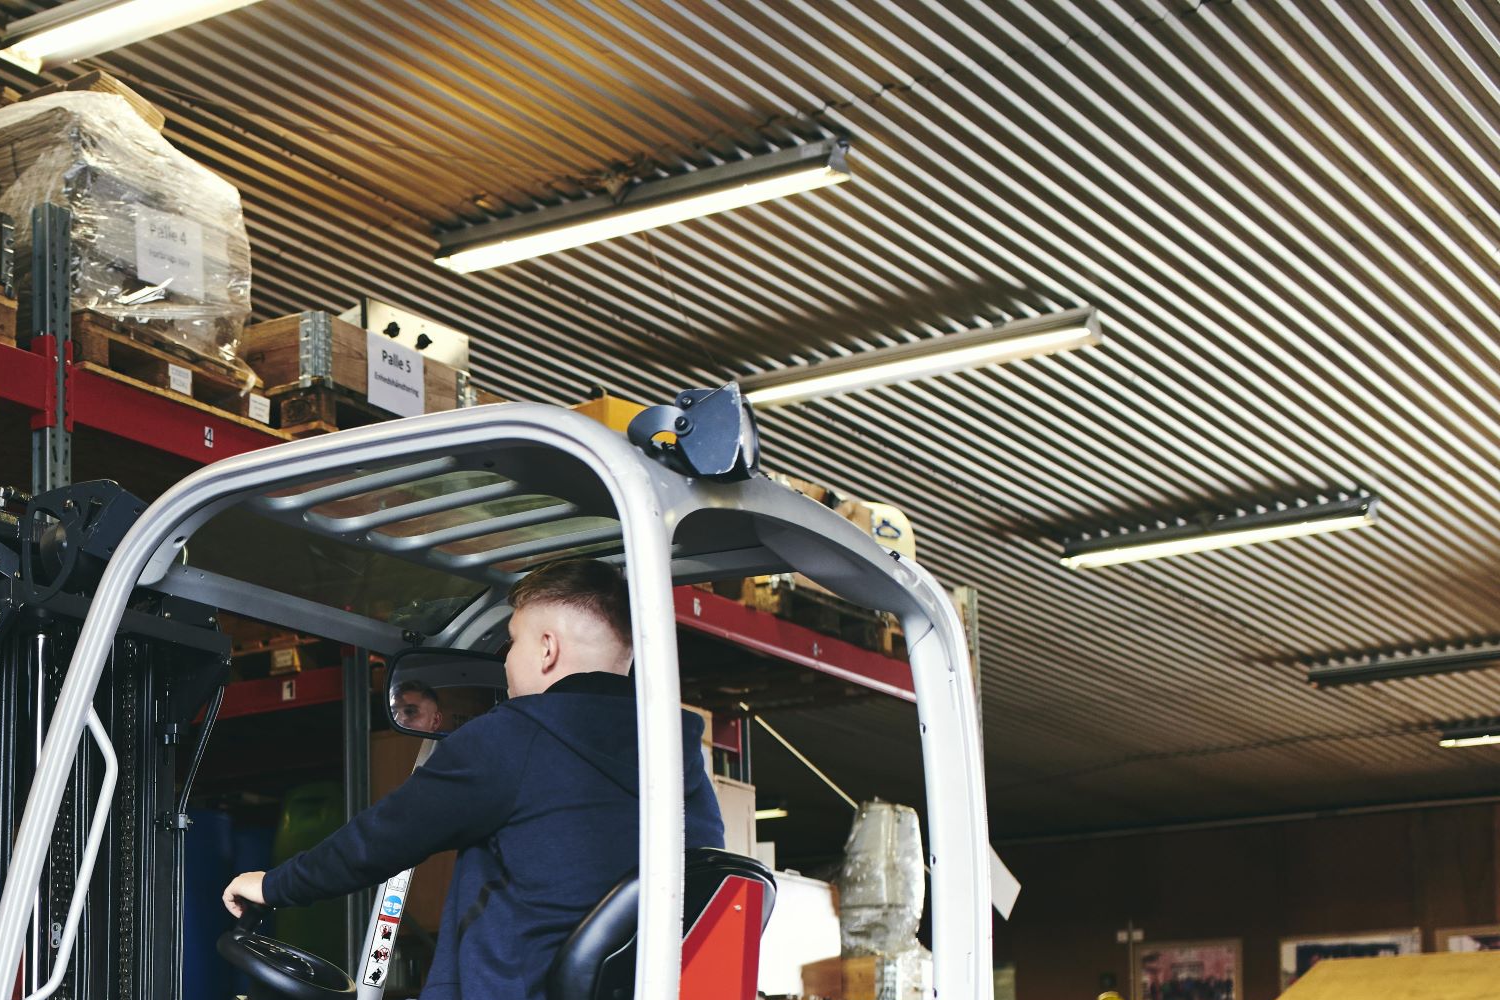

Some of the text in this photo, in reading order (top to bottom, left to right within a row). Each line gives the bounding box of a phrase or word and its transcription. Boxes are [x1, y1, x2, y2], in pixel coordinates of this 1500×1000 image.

[149, 223, 188, 245] Palle 4
[381, 349, 412, 373] Palle 5
[204, 428, 213, 446] 4
[286, 681, 293, 697] 1
